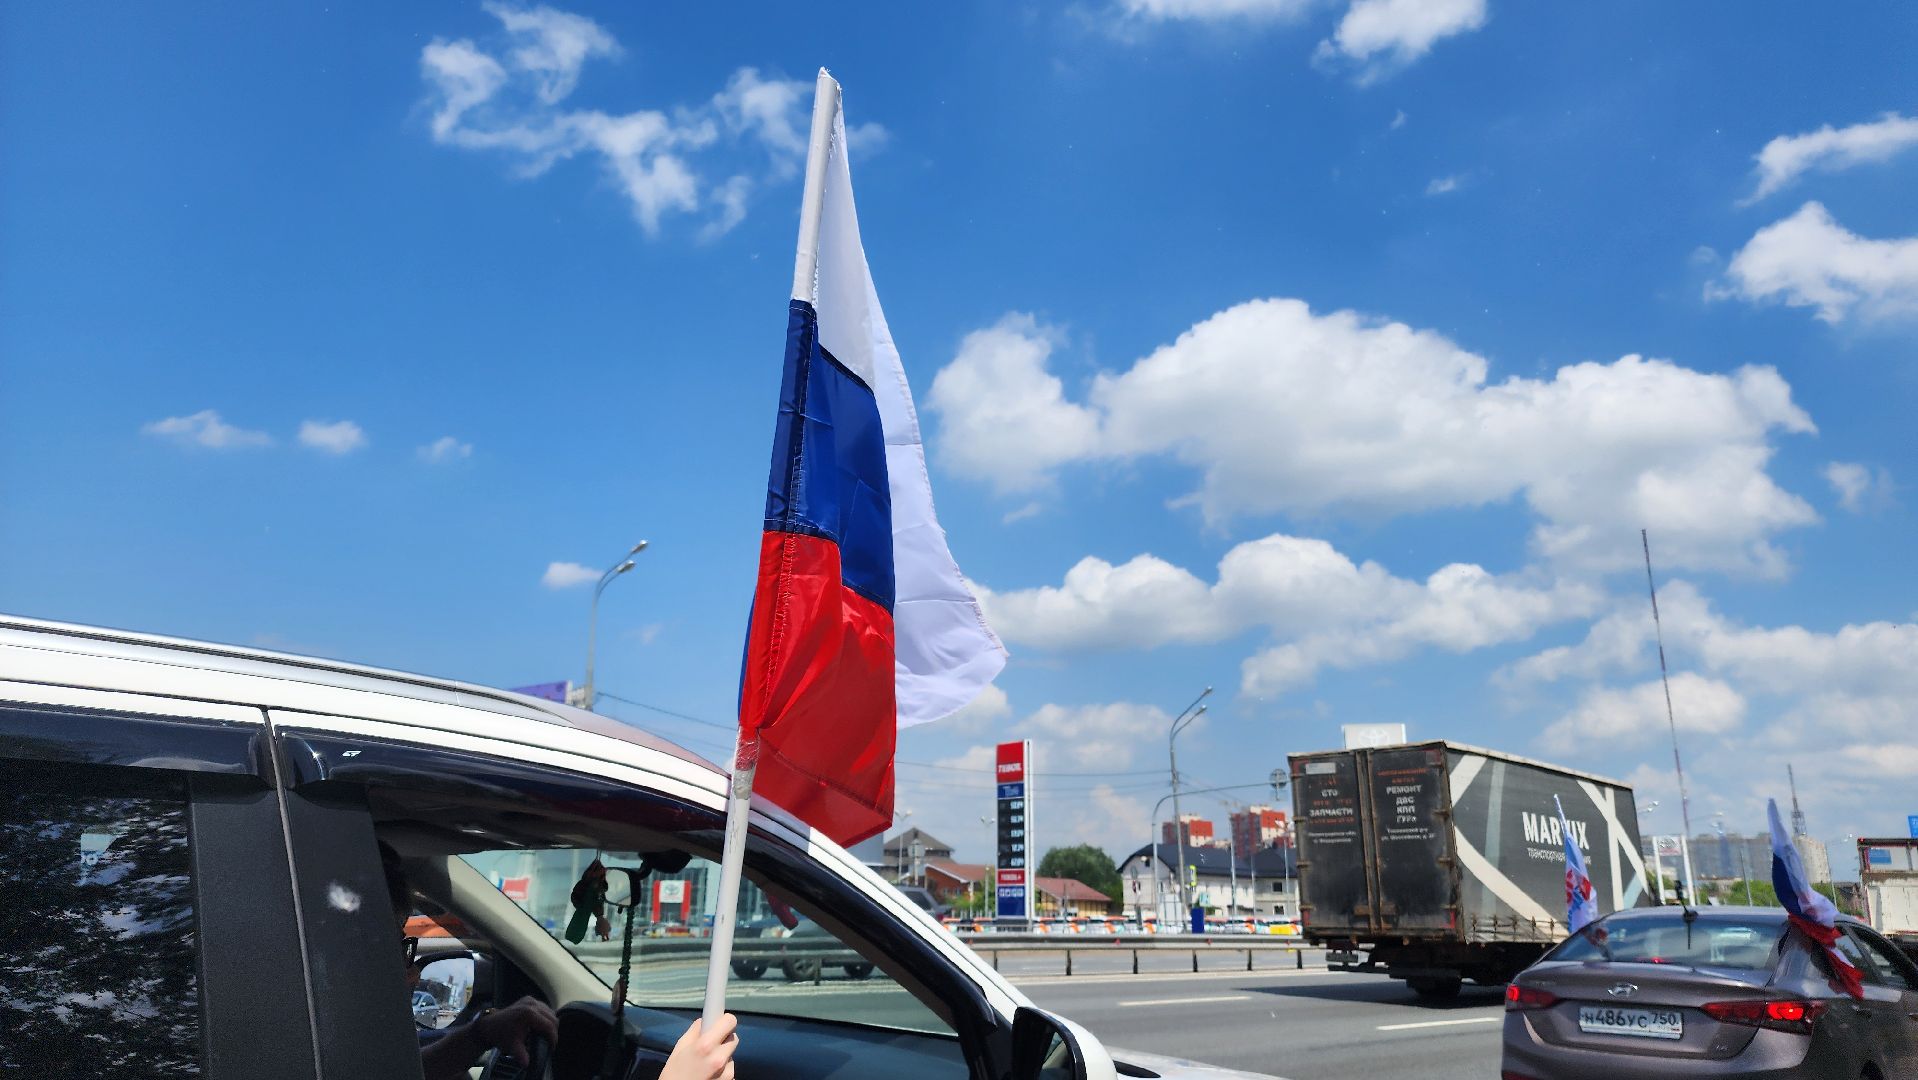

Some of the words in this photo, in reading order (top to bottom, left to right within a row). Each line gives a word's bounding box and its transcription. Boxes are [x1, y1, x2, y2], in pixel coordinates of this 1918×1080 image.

[1321, 788, 1338, 797] СТО
[1386, 784, 1422, 794] РЕМОНТ
[1396, 796, 1414, 805] ДВС
[1309, 807, 1353, 818] ЗАПЧАСТИ
[1397, 805, 1415, 814] КПП
[1650, 1012, 1676, 1026] 750
